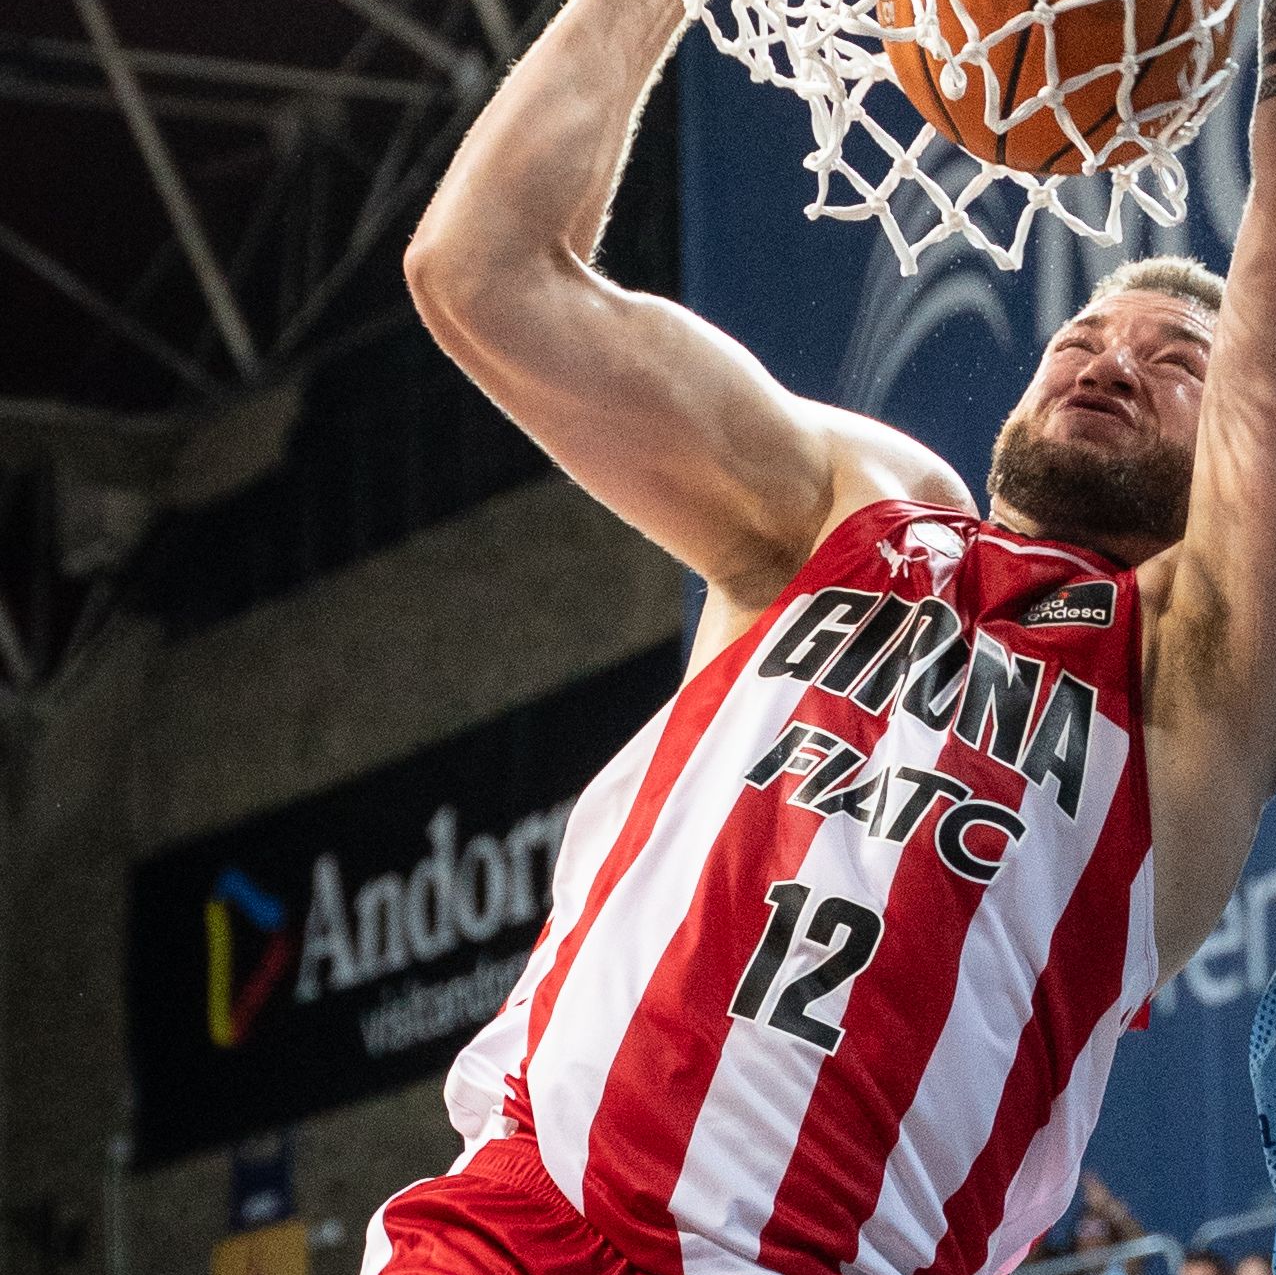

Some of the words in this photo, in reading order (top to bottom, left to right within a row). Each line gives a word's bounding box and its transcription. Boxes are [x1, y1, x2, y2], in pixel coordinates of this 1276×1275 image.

[1027, 606, 1107, 622] endesa
[757, 587, 1099, 821] GIRONA
[730, 880, 884, 1055] 12
